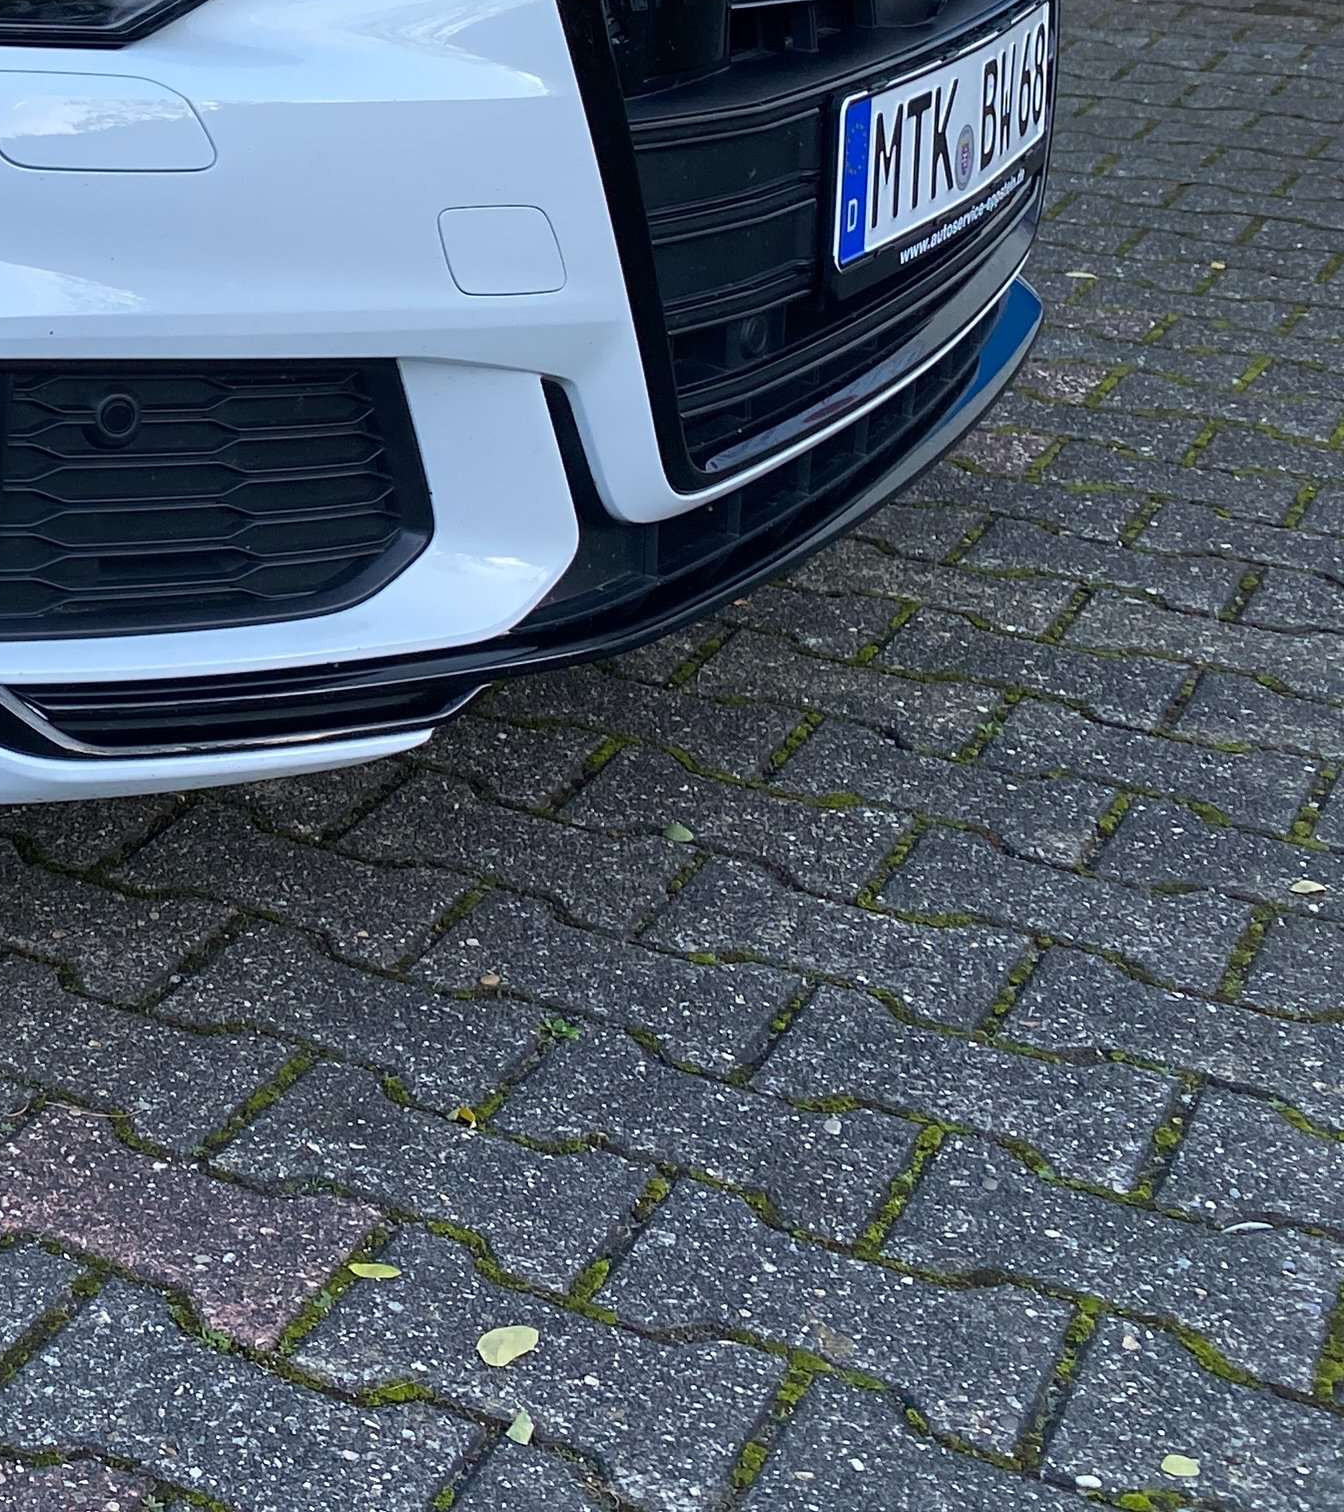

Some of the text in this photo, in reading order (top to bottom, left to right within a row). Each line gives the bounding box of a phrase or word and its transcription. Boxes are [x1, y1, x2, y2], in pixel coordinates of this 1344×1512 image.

[871, 76, 960, 229] MTK
[980, 42, 1016, 171] BW
[1018, 22, 1046, 137] 68
[846, 198, 859, 233] D
